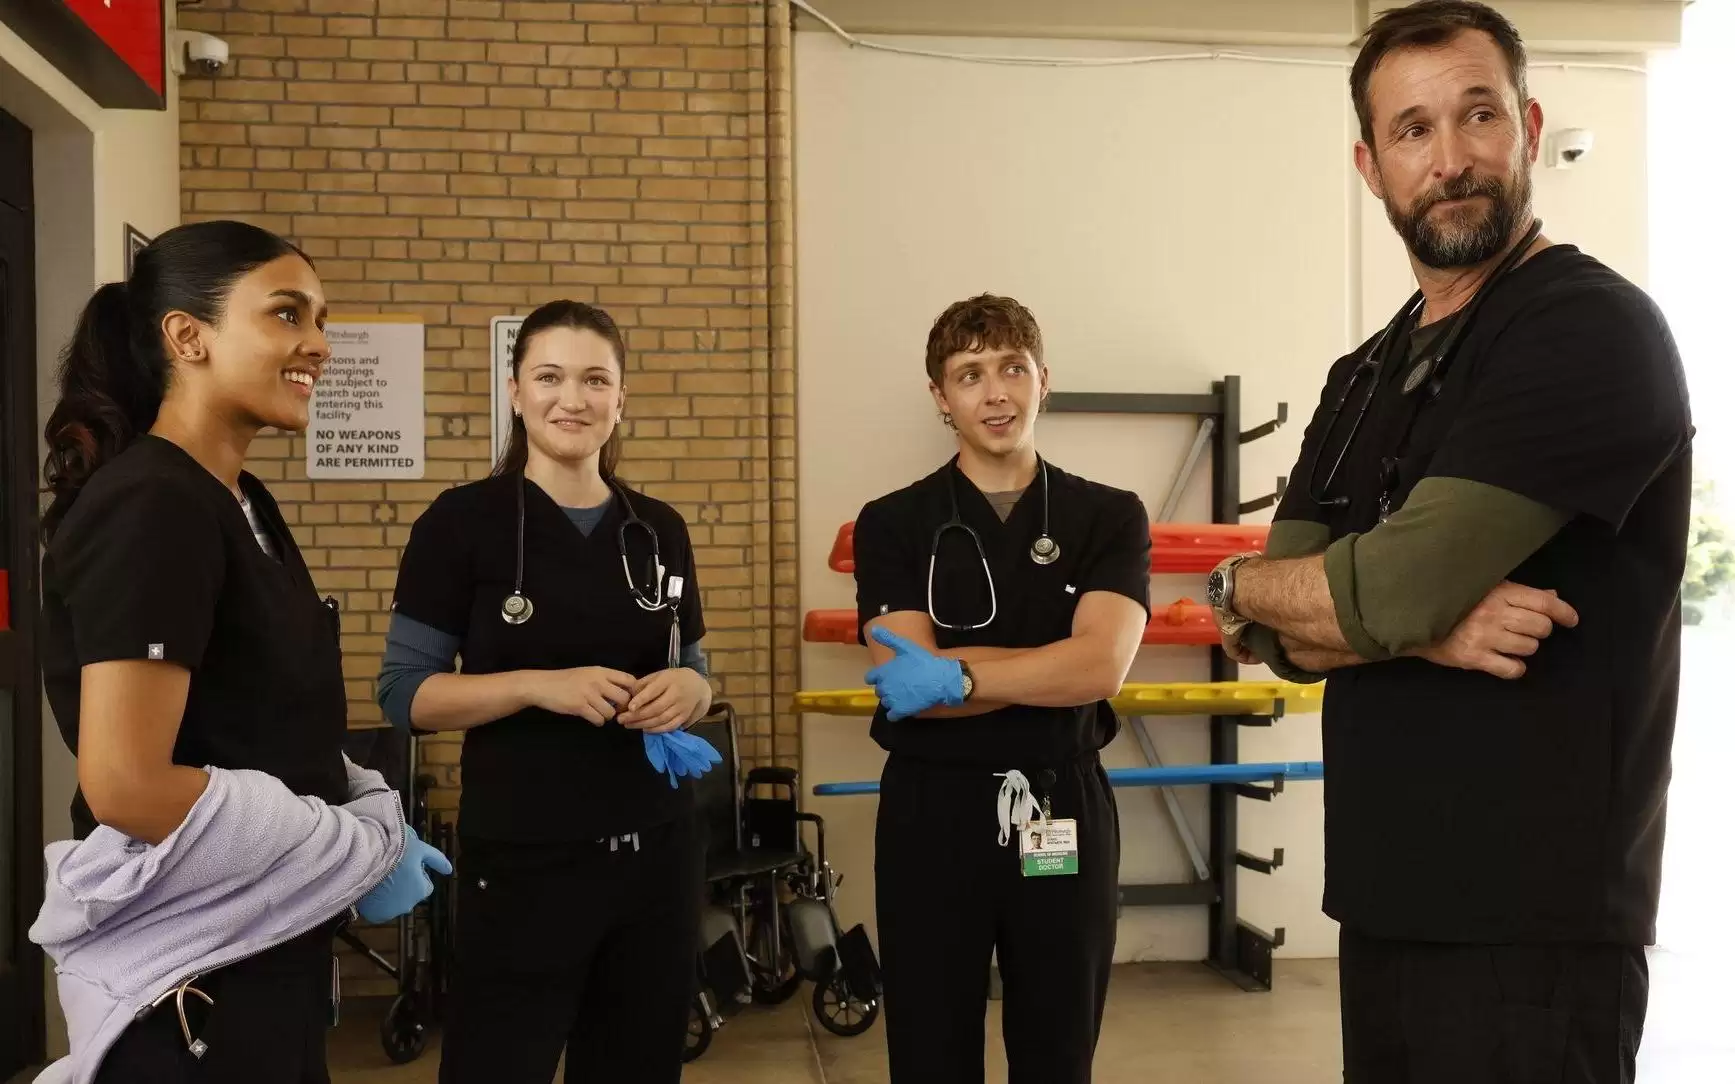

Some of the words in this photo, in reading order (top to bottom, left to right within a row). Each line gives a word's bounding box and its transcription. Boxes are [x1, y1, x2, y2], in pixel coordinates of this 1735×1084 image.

[359, 356, 379, 365] and
[322, 365, 374, 377] elongings
[316, 379, 332, 387] are
[335, 377, 373, 389] subject
[376, 378, 387, 387] to
[315, 388, 349, 398] search
[352, 390, 380, 400] upon
[315, 399, 361, 411] entering
[364, 399, 383, 409] this
[316, 410, 352, 422] facility
[316, 430, 335, 440] NO
[339, 430, 401, 440] WEAPONS
[316, 444, 333, 454] OF
[336, 444, 363, 454] ANY
[367, 444, 399, 454] KIND
[316, 457, 341, 468] ARE
[344, 457, 414, 468] PERMITTED
